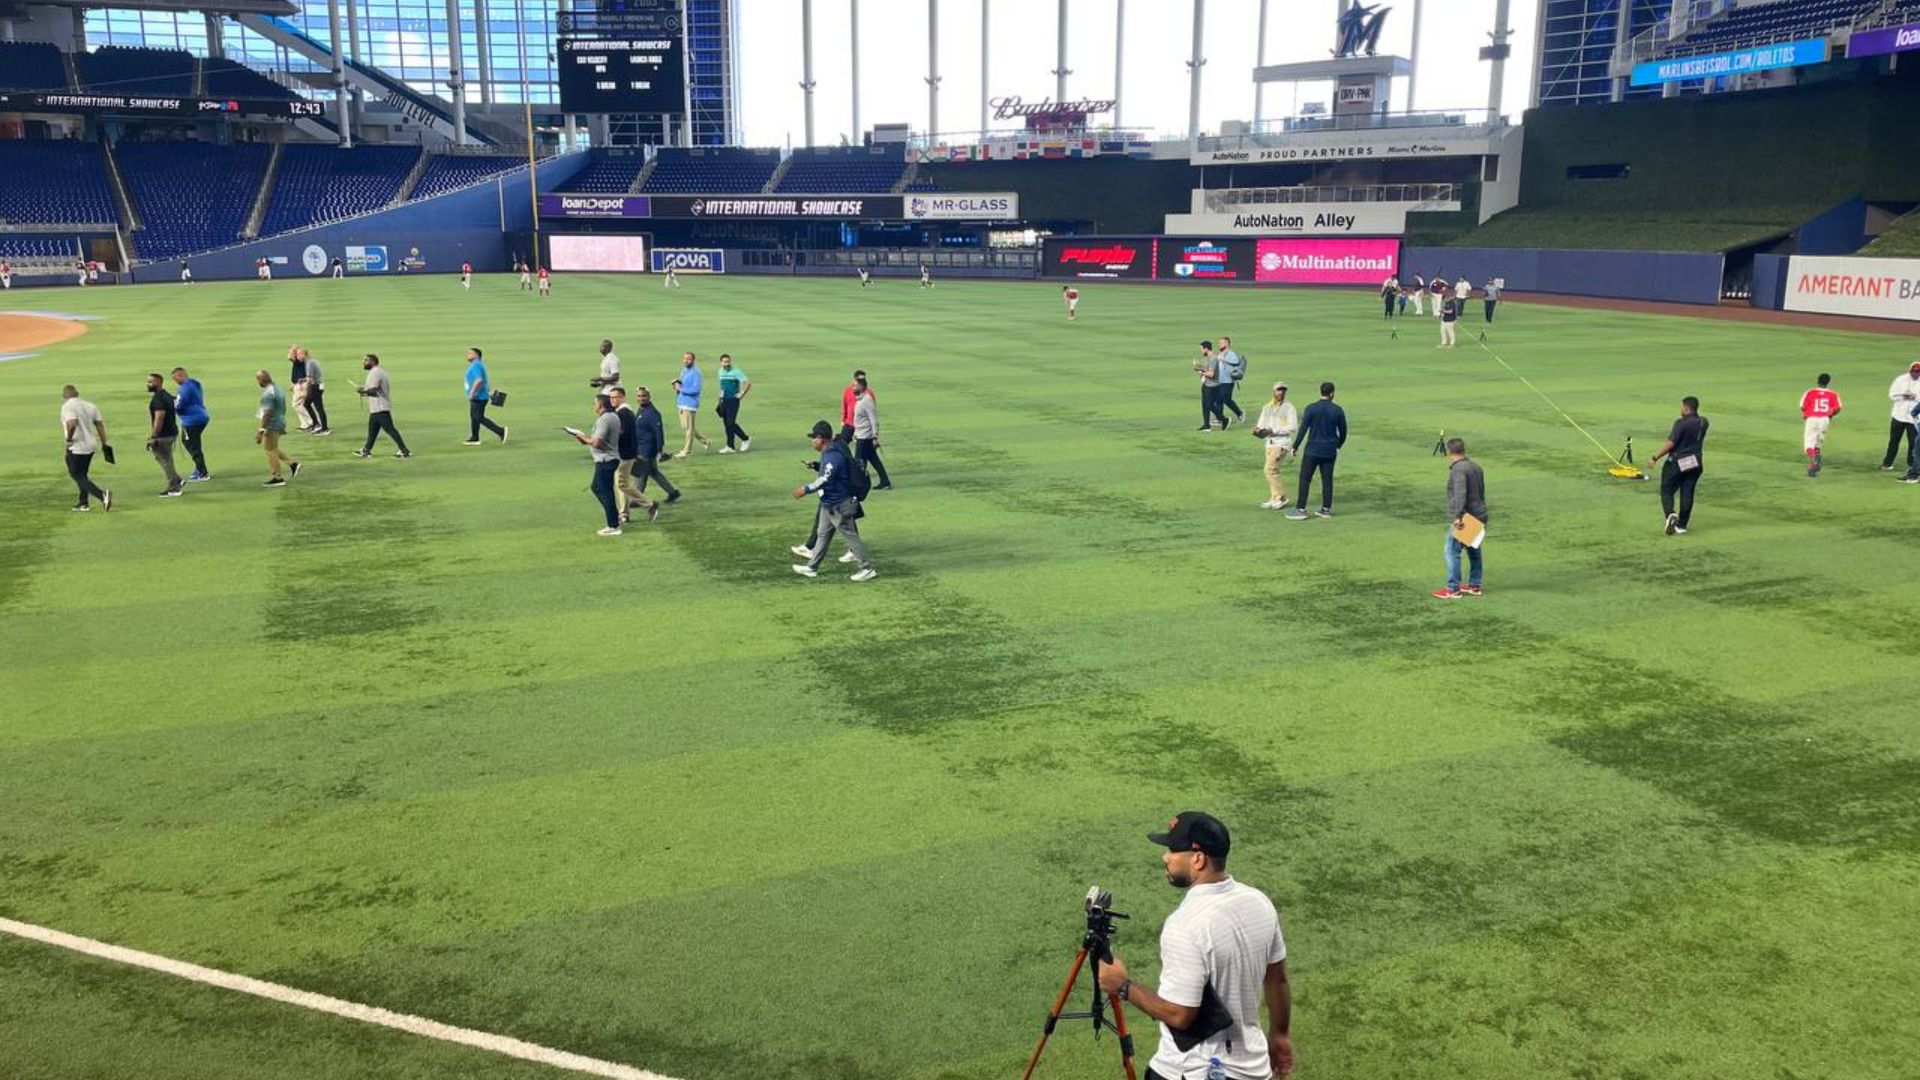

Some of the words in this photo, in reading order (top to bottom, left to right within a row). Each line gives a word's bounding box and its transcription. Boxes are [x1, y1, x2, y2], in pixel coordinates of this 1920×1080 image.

[46, 95, 126, 108] INTERNATIONAL
[129, 98, 181, 109] SHOWCASE
[289, 102, 321, 115] 12:43
[989, 95, 1117, 121] Budweiser
[407, 102, 437, 129] LEVEL
[1212, 151, 1249, 161] AutoNation
[1260, 151, 1297, 159] PROUD
[1303, 147, 1373, 157] PARTNERS
[562, 197, 624, 210] loanDepot
[705, 200, 799, 215] INTERNATIONAL
[801, 200, 863, 216] SHOWCASE
[1233, 214, 1304, 229] AutoNation
[1314, 213, 1355, 230] Alley
[665, 253, 710, 267] GOYA
[1282, 255, 1393, 270] Multinational
[1797, 274, 1896, 298] AMERANT
[1813, 399, 1830, 413] 15
